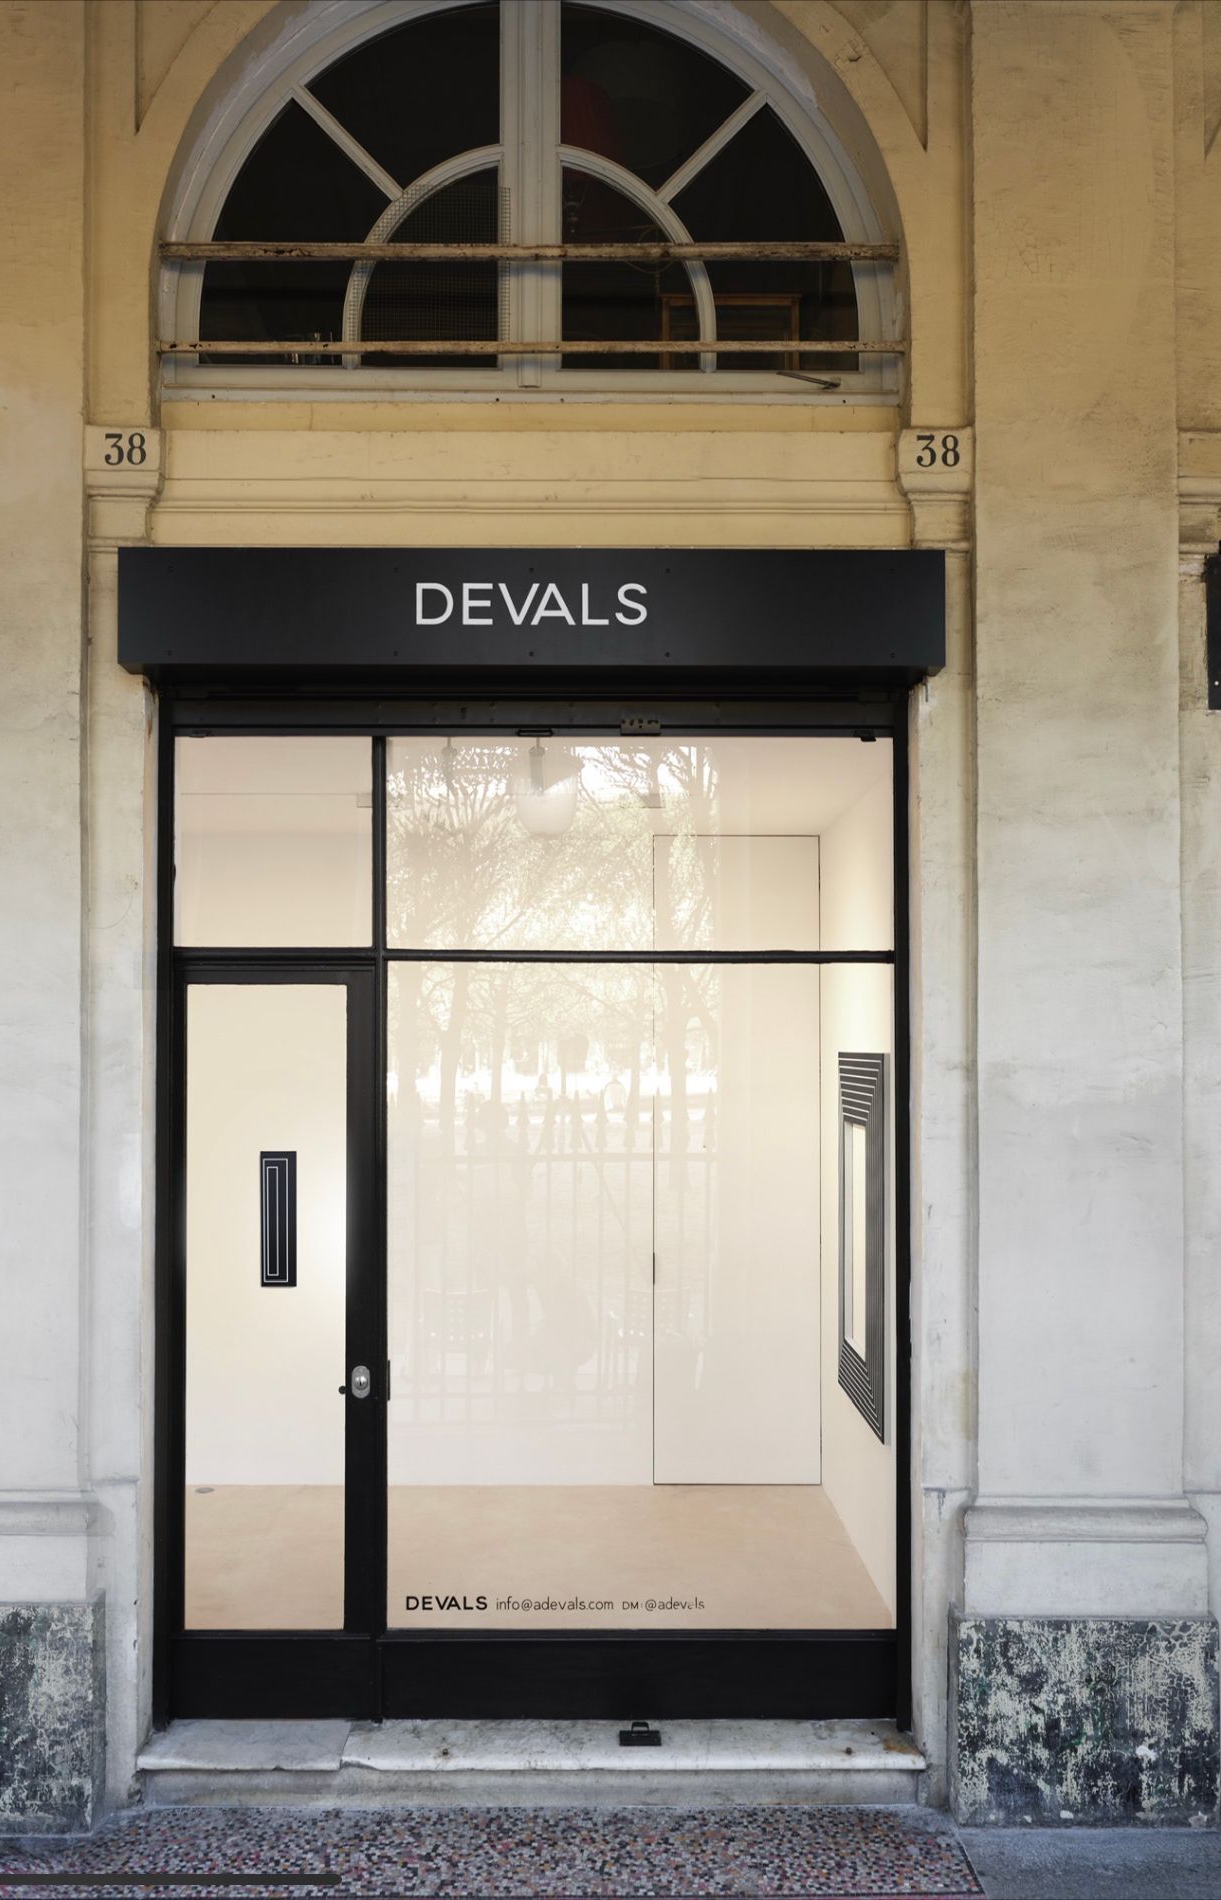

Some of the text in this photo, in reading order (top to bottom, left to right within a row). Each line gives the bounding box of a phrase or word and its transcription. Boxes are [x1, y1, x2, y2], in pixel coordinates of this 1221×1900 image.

[104, 432, 147, 466] 38
[916, 434, 960, 468] 38
[414, 582, 648, 627] DEVALS
[405, 1595, 488, 1611] DEVALS
[495, 1596, 615, 1612] info@adevals.com
